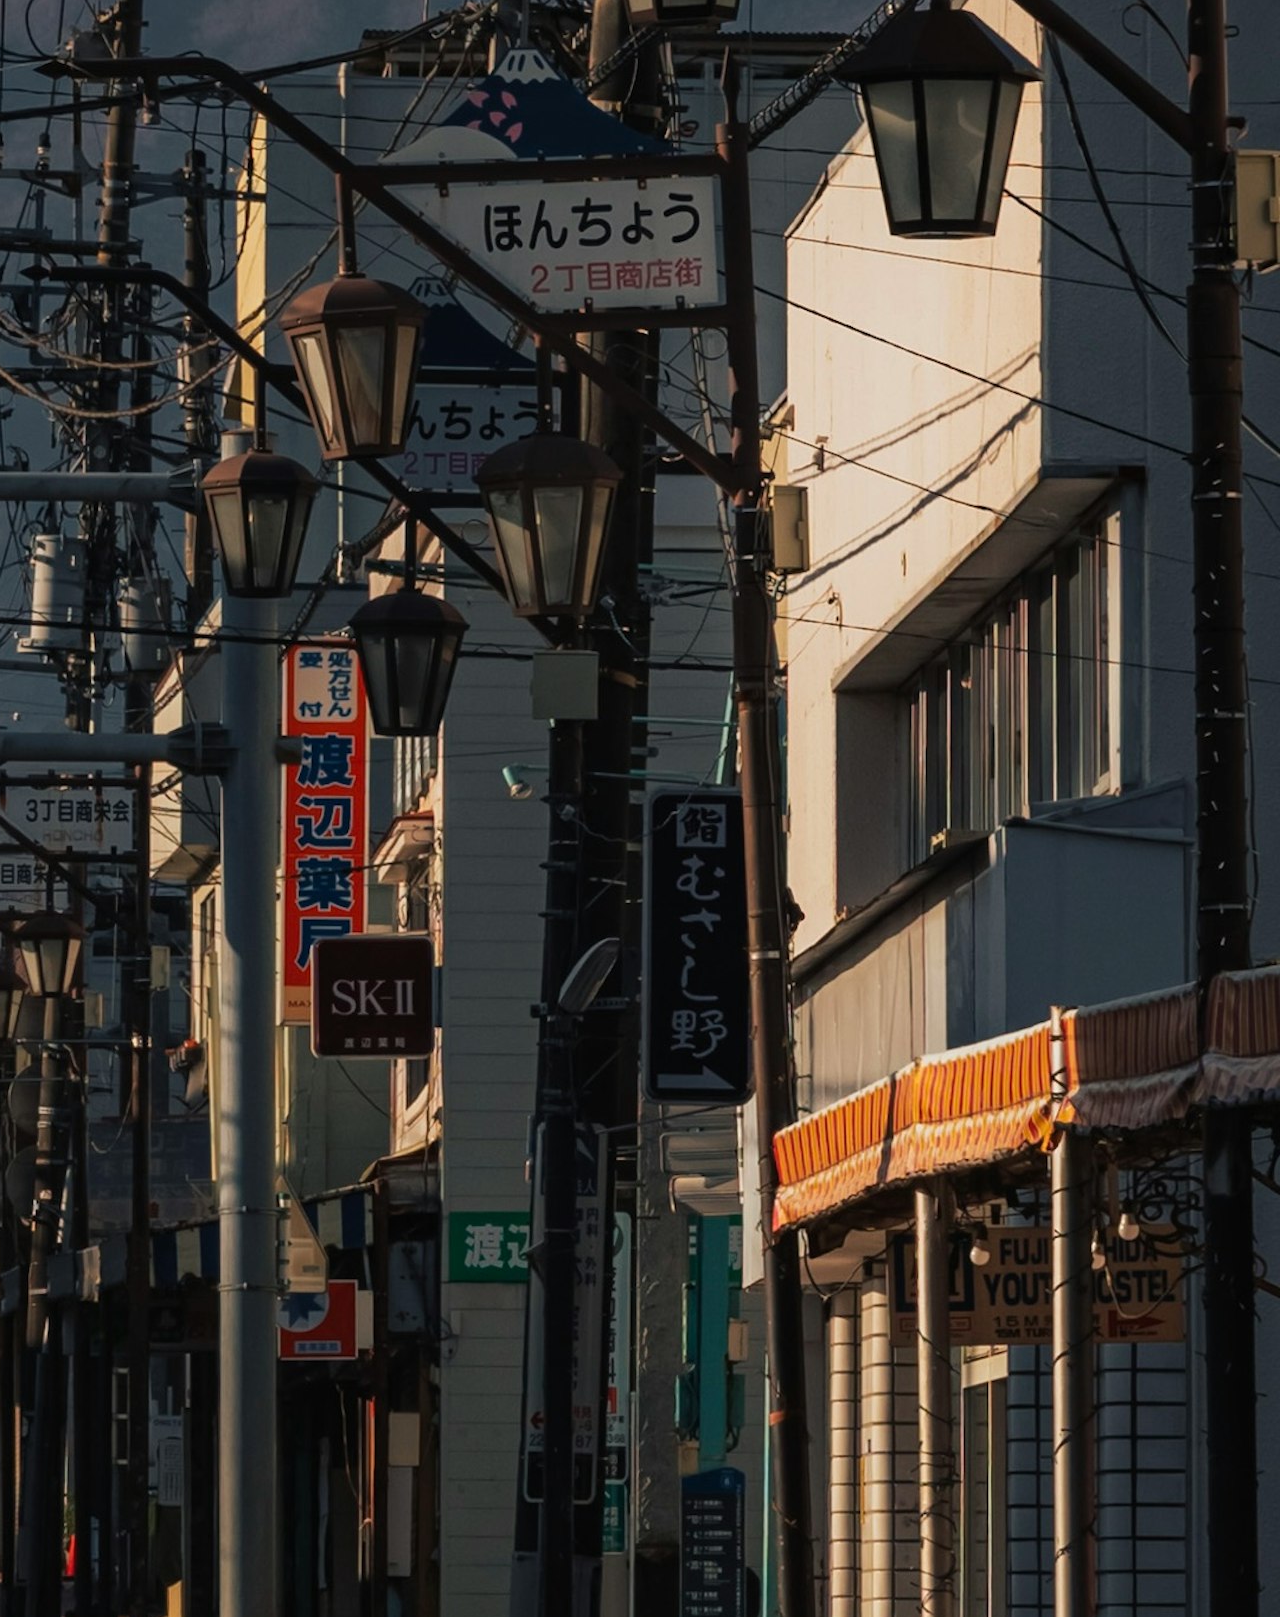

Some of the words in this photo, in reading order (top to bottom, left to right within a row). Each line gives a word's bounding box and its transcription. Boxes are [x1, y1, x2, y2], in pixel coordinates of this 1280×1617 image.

[484, 192, 701, 252] ほんちょう
[531, 258, 703, 294] 2丁目商店街
[407, 400, 537, 440] んちょう
[328, 651, 352, 717] 処方せん
[25, 799, 130, 823] 3丁目商栄会
[679, 807, 721, 844] 鮨
[669, 853, 729, 1058] むさし野
[331, 978, 416, 1016] SK-II
[344, 1036, 406, 1049] 渡辺薬局
[1000, 1238, 1049, 1265] FUJI
[983, 1272, 1052, 1306] YOUT
[1091, 1269, 1175, 1304] OSTEL
